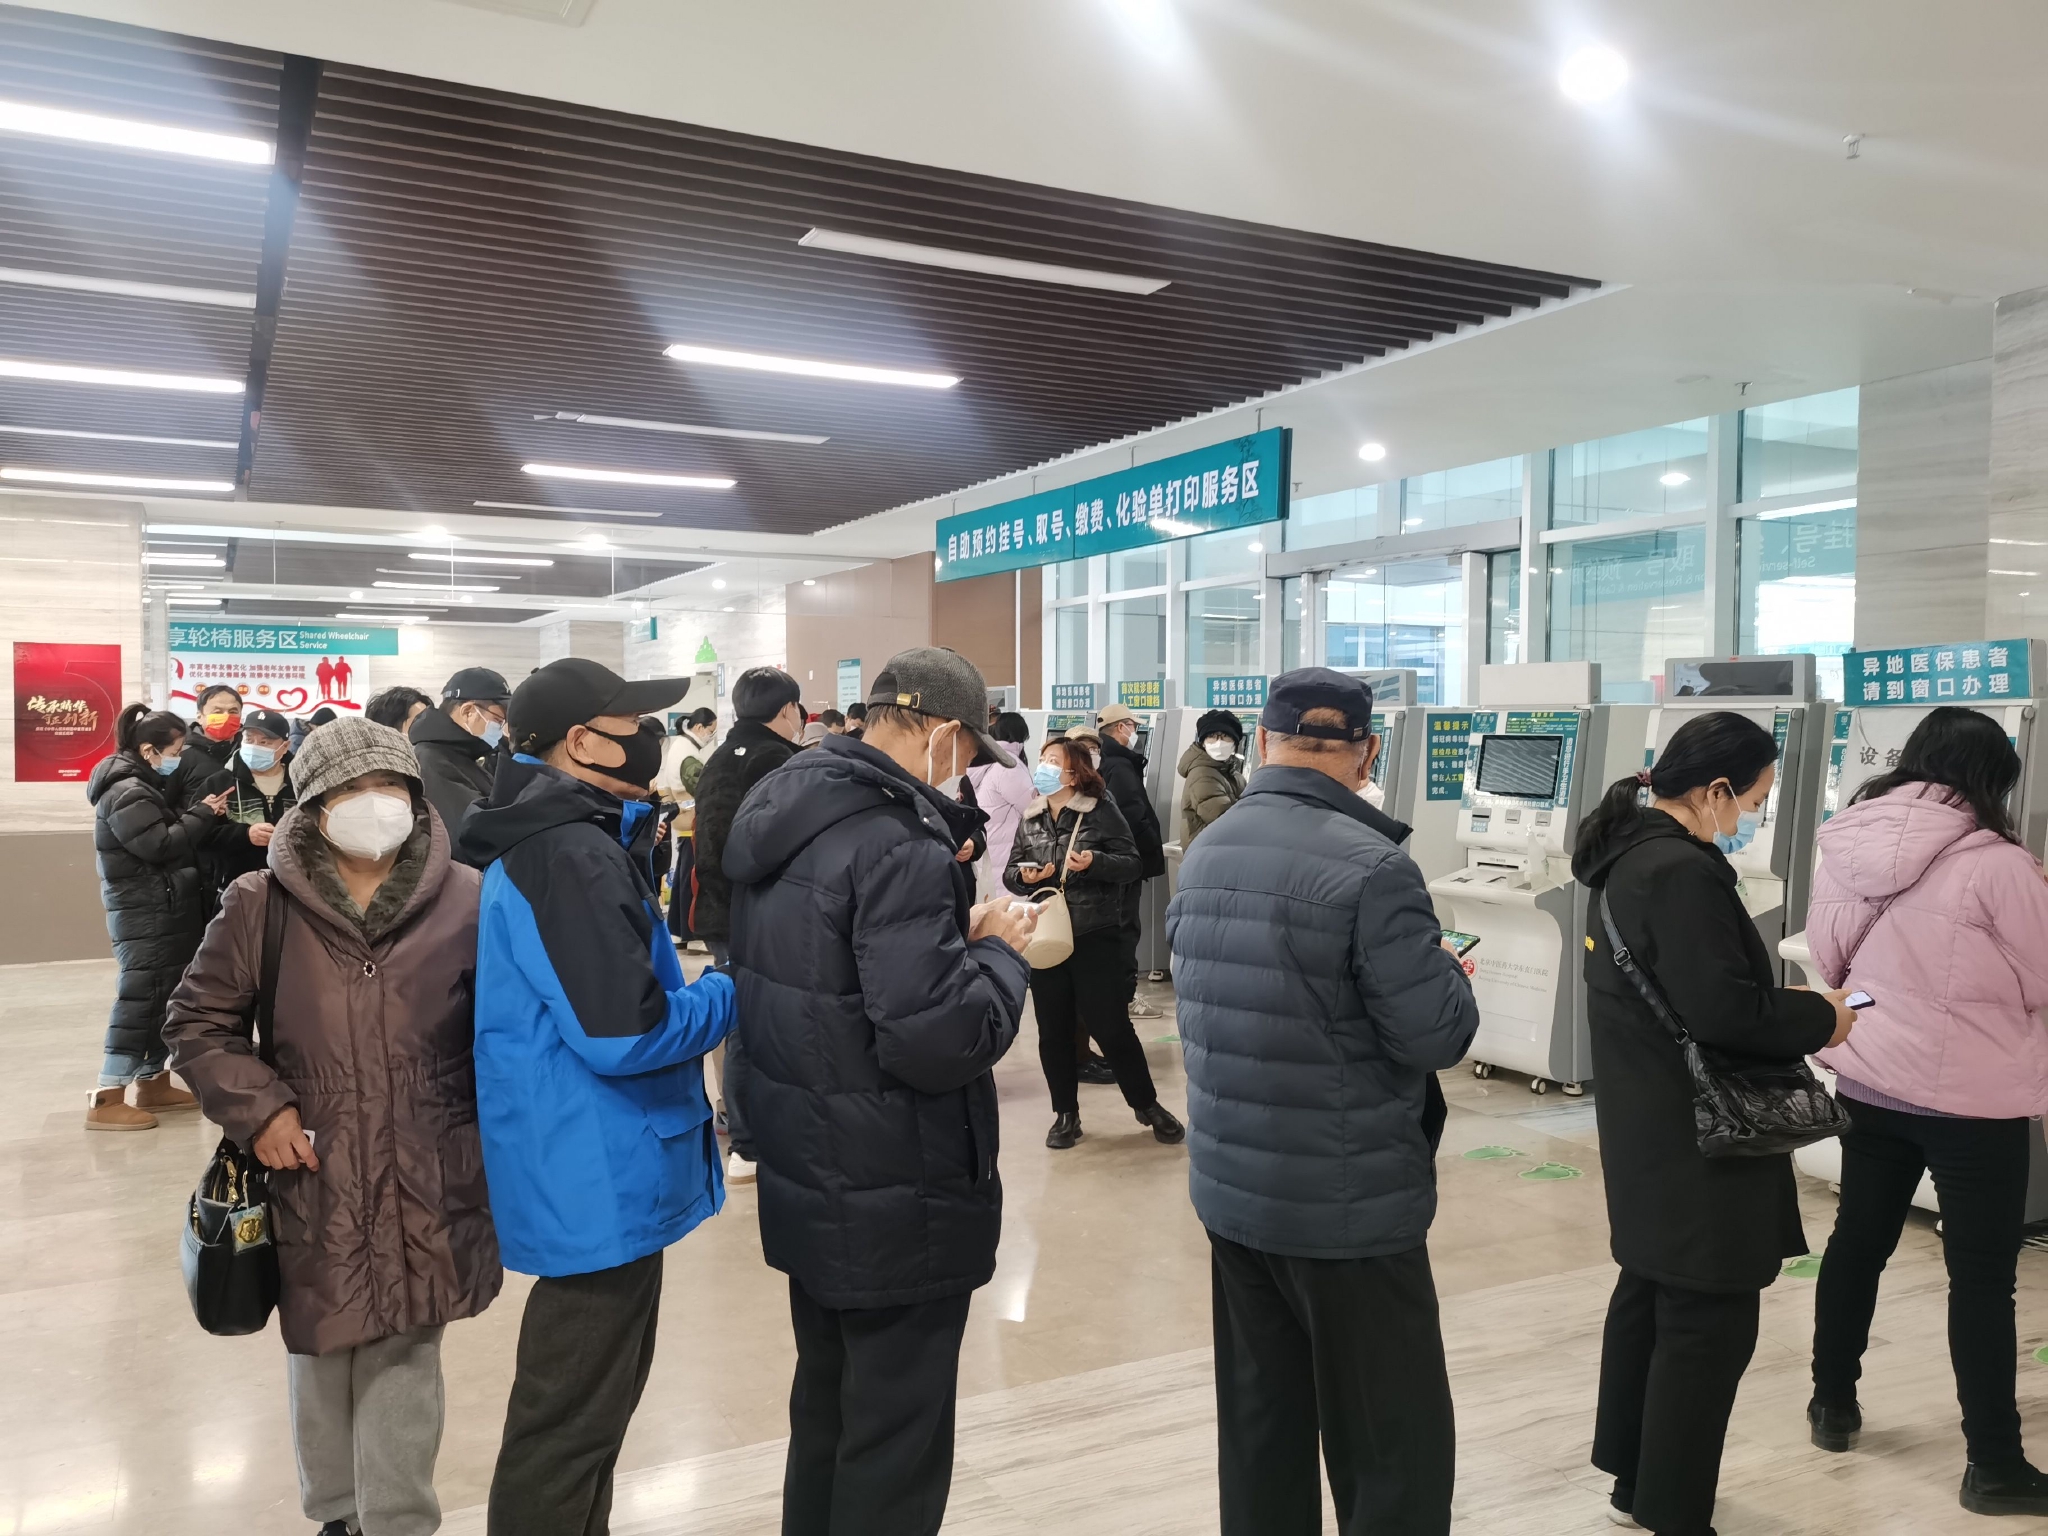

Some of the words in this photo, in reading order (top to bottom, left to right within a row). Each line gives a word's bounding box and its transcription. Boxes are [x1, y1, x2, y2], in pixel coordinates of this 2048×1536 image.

[948, 459, 1260, 563] 自助预约挂号、取号、缴费、化验单打印服务区
[169, 627, 299, 649] 享轮椅服务区
[299, 631, 327, 640] Shared
[328, 631, 370, 641] Wheelchair
[299, 641, 328, 650] Service
[1862, 646, 2009, 676] 异地医保患者
[1212, 679, 1262, 692] 异地医保患者
[1863, 673, 2010, 701] 请到窗口办理
[1212, 693, 1262, 706] 请到窗口办理
